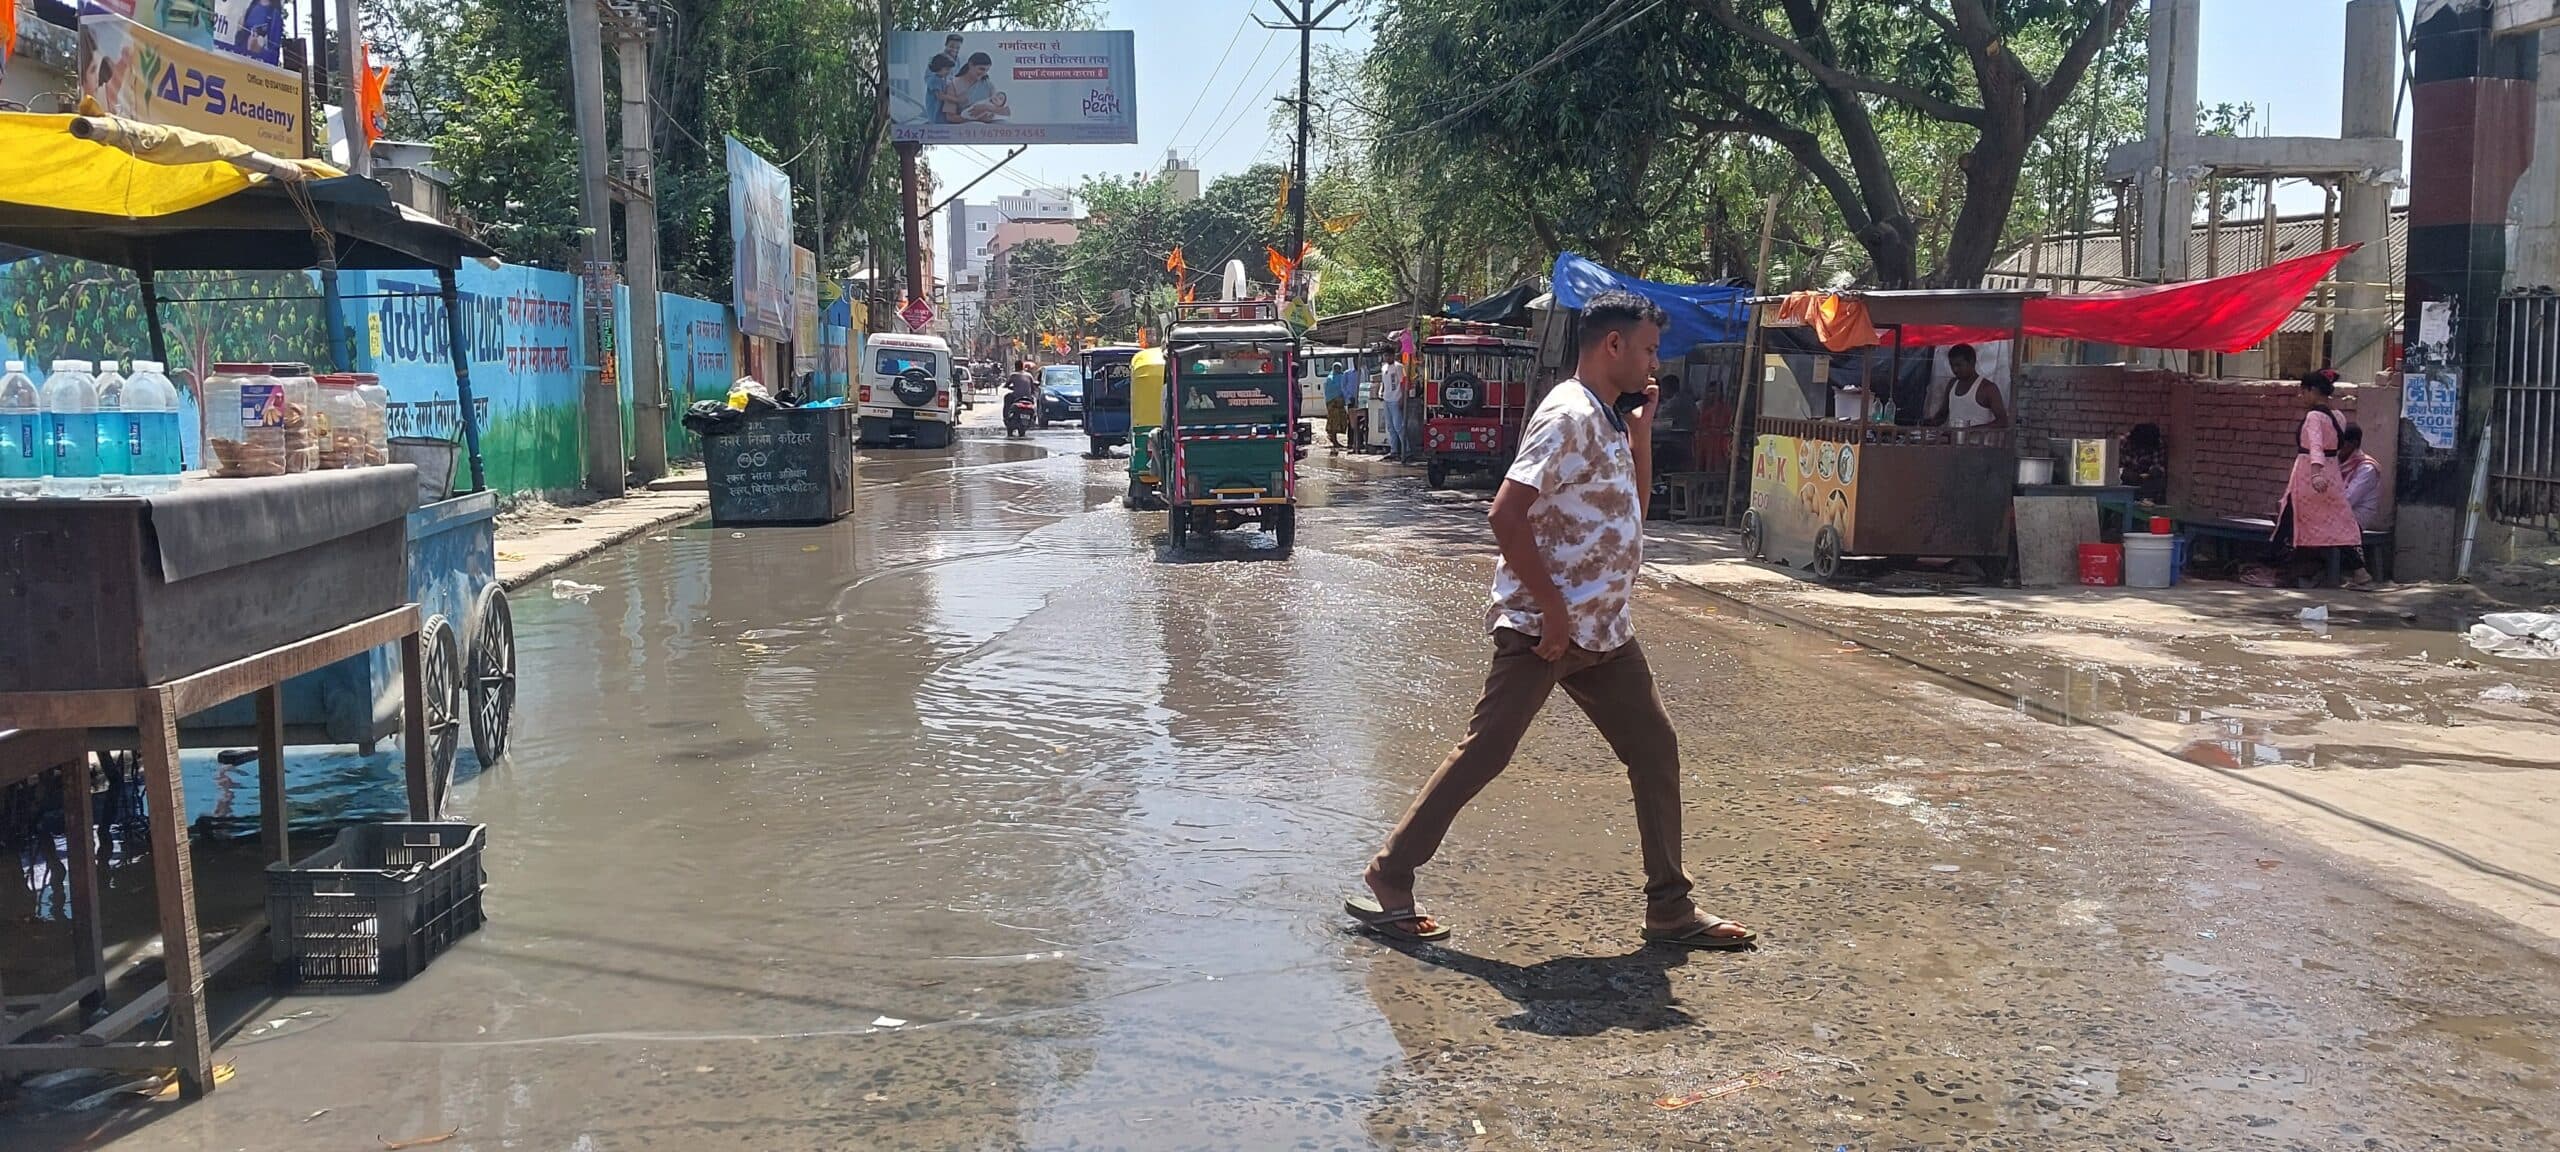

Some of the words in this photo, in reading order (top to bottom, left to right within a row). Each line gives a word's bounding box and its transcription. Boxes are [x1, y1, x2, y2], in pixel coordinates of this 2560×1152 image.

[1015, 55, 1037, 65] बाल
[1040, 53, 1086, 65] चिकित्सा
[1088, 55, 1109, 65] तक
[157, 62, 226, 115] APS
[1091, 89, 1115, 104] Pam
[230, 93, 295, 132] Academy
[476, 294, 504, 363] 2025
